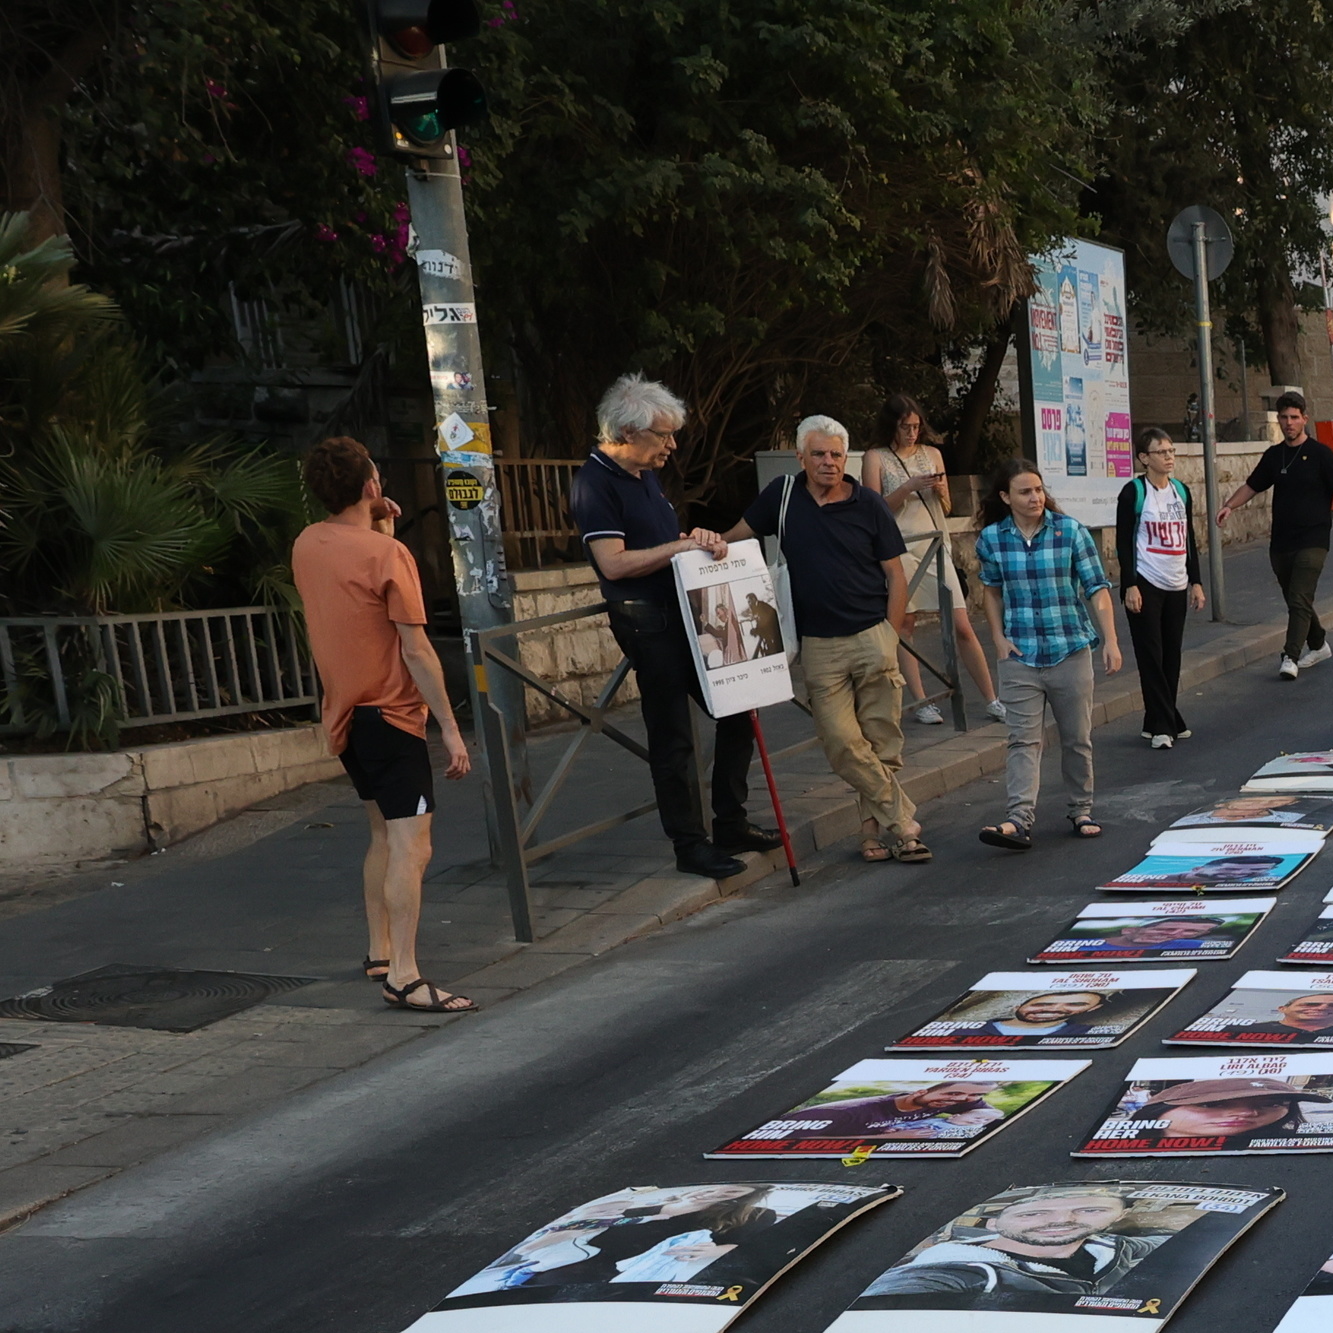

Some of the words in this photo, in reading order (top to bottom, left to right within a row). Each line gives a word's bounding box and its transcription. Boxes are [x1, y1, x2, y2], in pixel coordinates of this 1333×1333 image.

[1041, 408, 1061, 430] פרסם
[731, 558, 746, 568] שתי
[699, 563, 729, 575] מרפסות
[1219, 1063, 1247, 1071] LIRI
[1244, 1062, 1287, 1070] ALBAG
[757, 1120, 833, 1130] BRING
[1101, 1119, 1171, 1130] BRING
[742, 1129, 796, 1140] HIM
[1092, 1129, 1140, 1140] HER
[721, 1140, 795, 1152] HOME
[1084, 1138, 1151, 1150] HOME
[1156, 1136, 1229, 1149] NOW!
